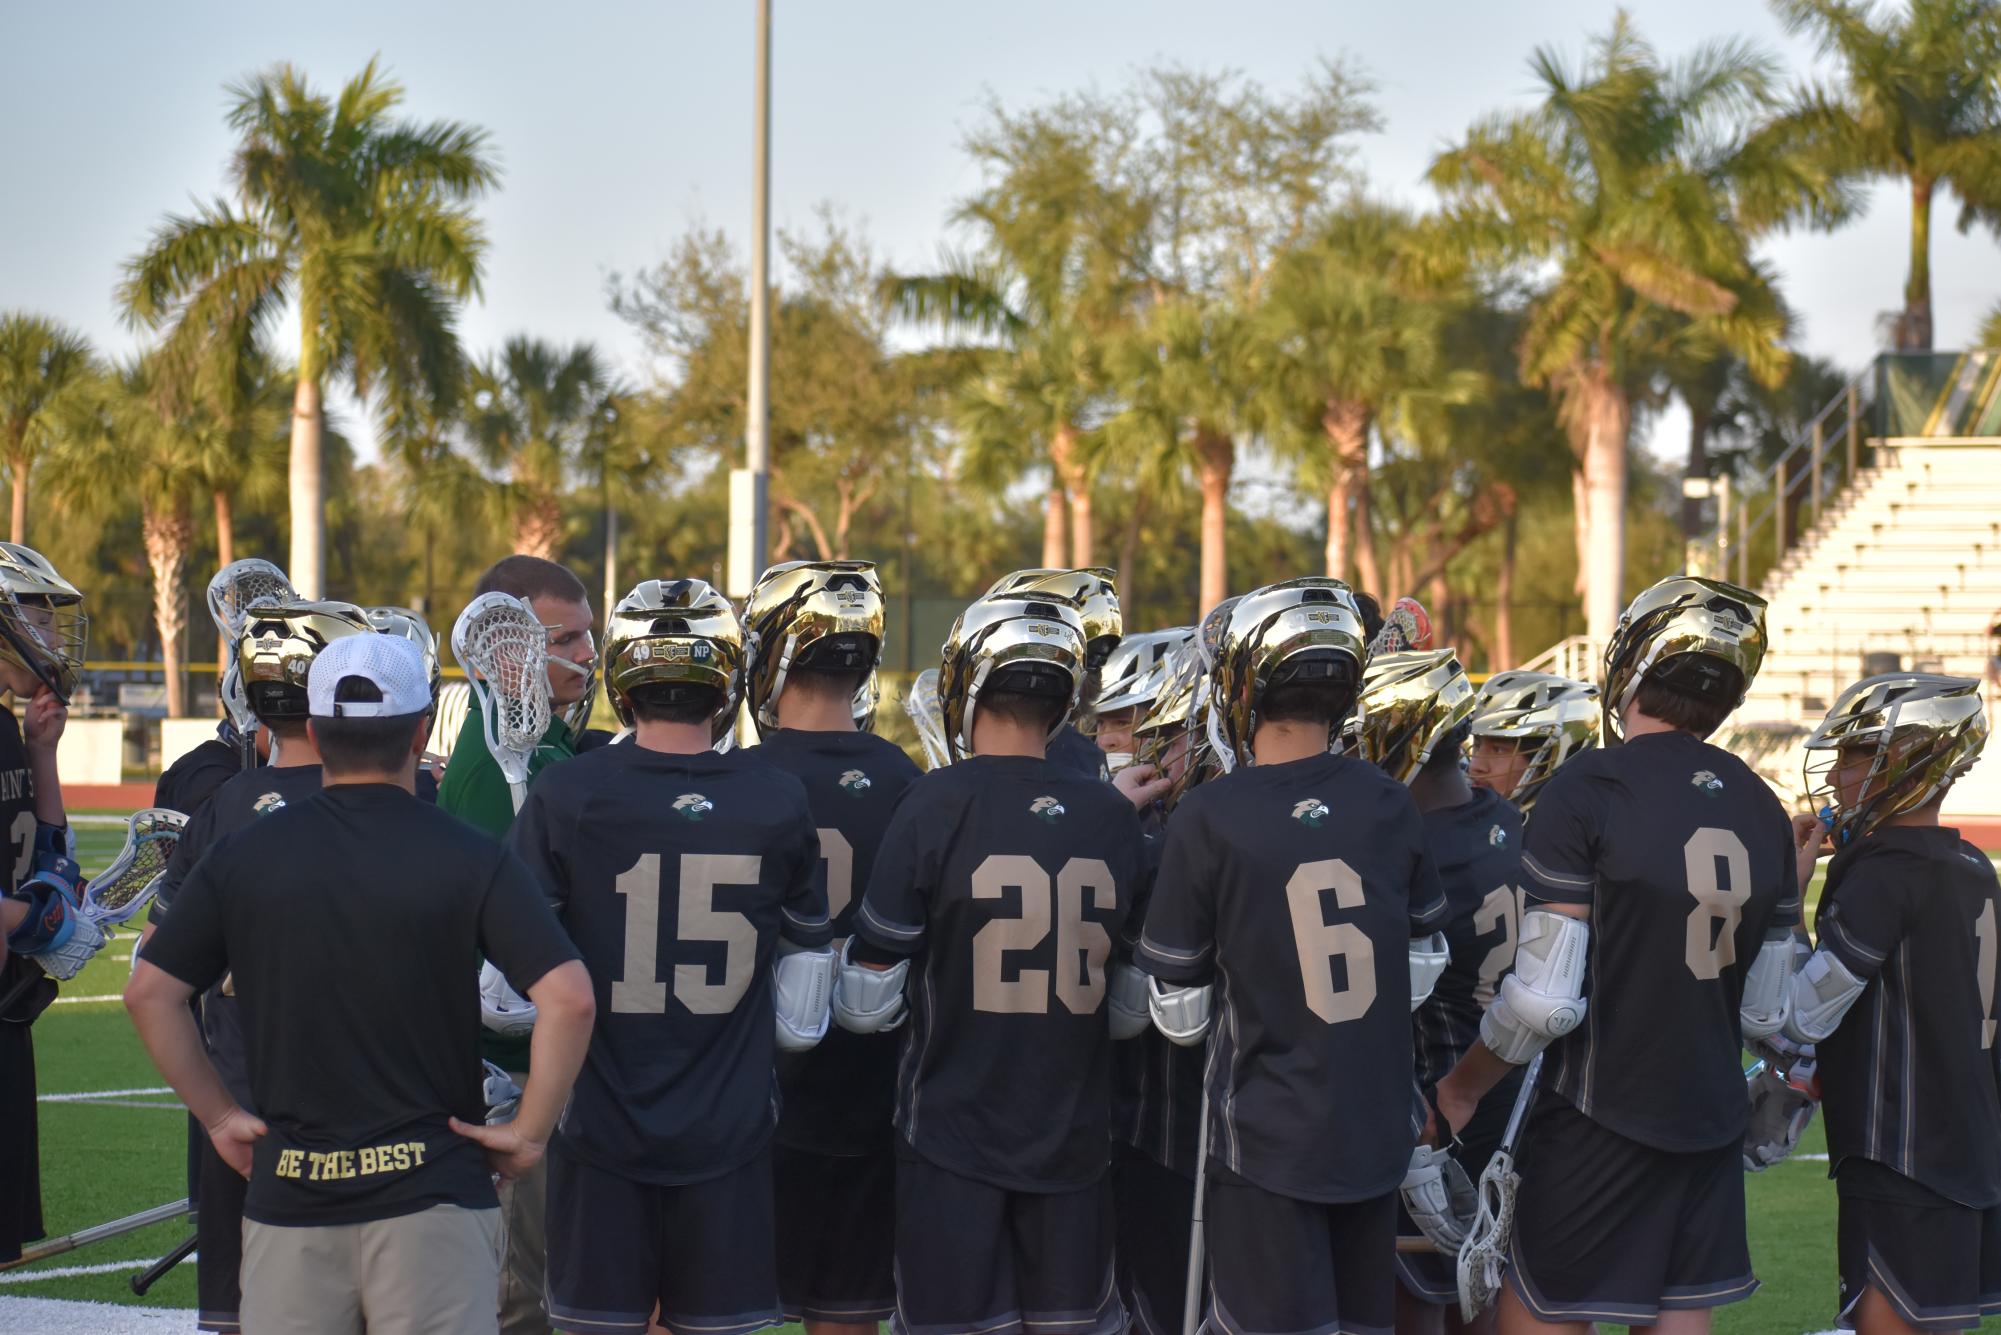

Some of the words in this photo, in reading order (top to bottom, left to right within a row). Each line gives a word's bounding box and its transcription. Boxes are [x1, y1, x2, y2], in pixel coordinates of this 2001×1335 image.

[287, 659, 306, 674] 40
[633, 645, 650, 660] 49
[694, 645, 710, 658] NP
[611, 853, 762, 1015] 15
[971, 854, 1116, 1014] 26
[1285, 858, 1377, 1025] 6
[1684, 827, 1751, 980] 8
[276, 1149, 305, 1178] BE
[308, 1151, 357, 1181] THE
[358, 1142, 426, 1175] BEST
